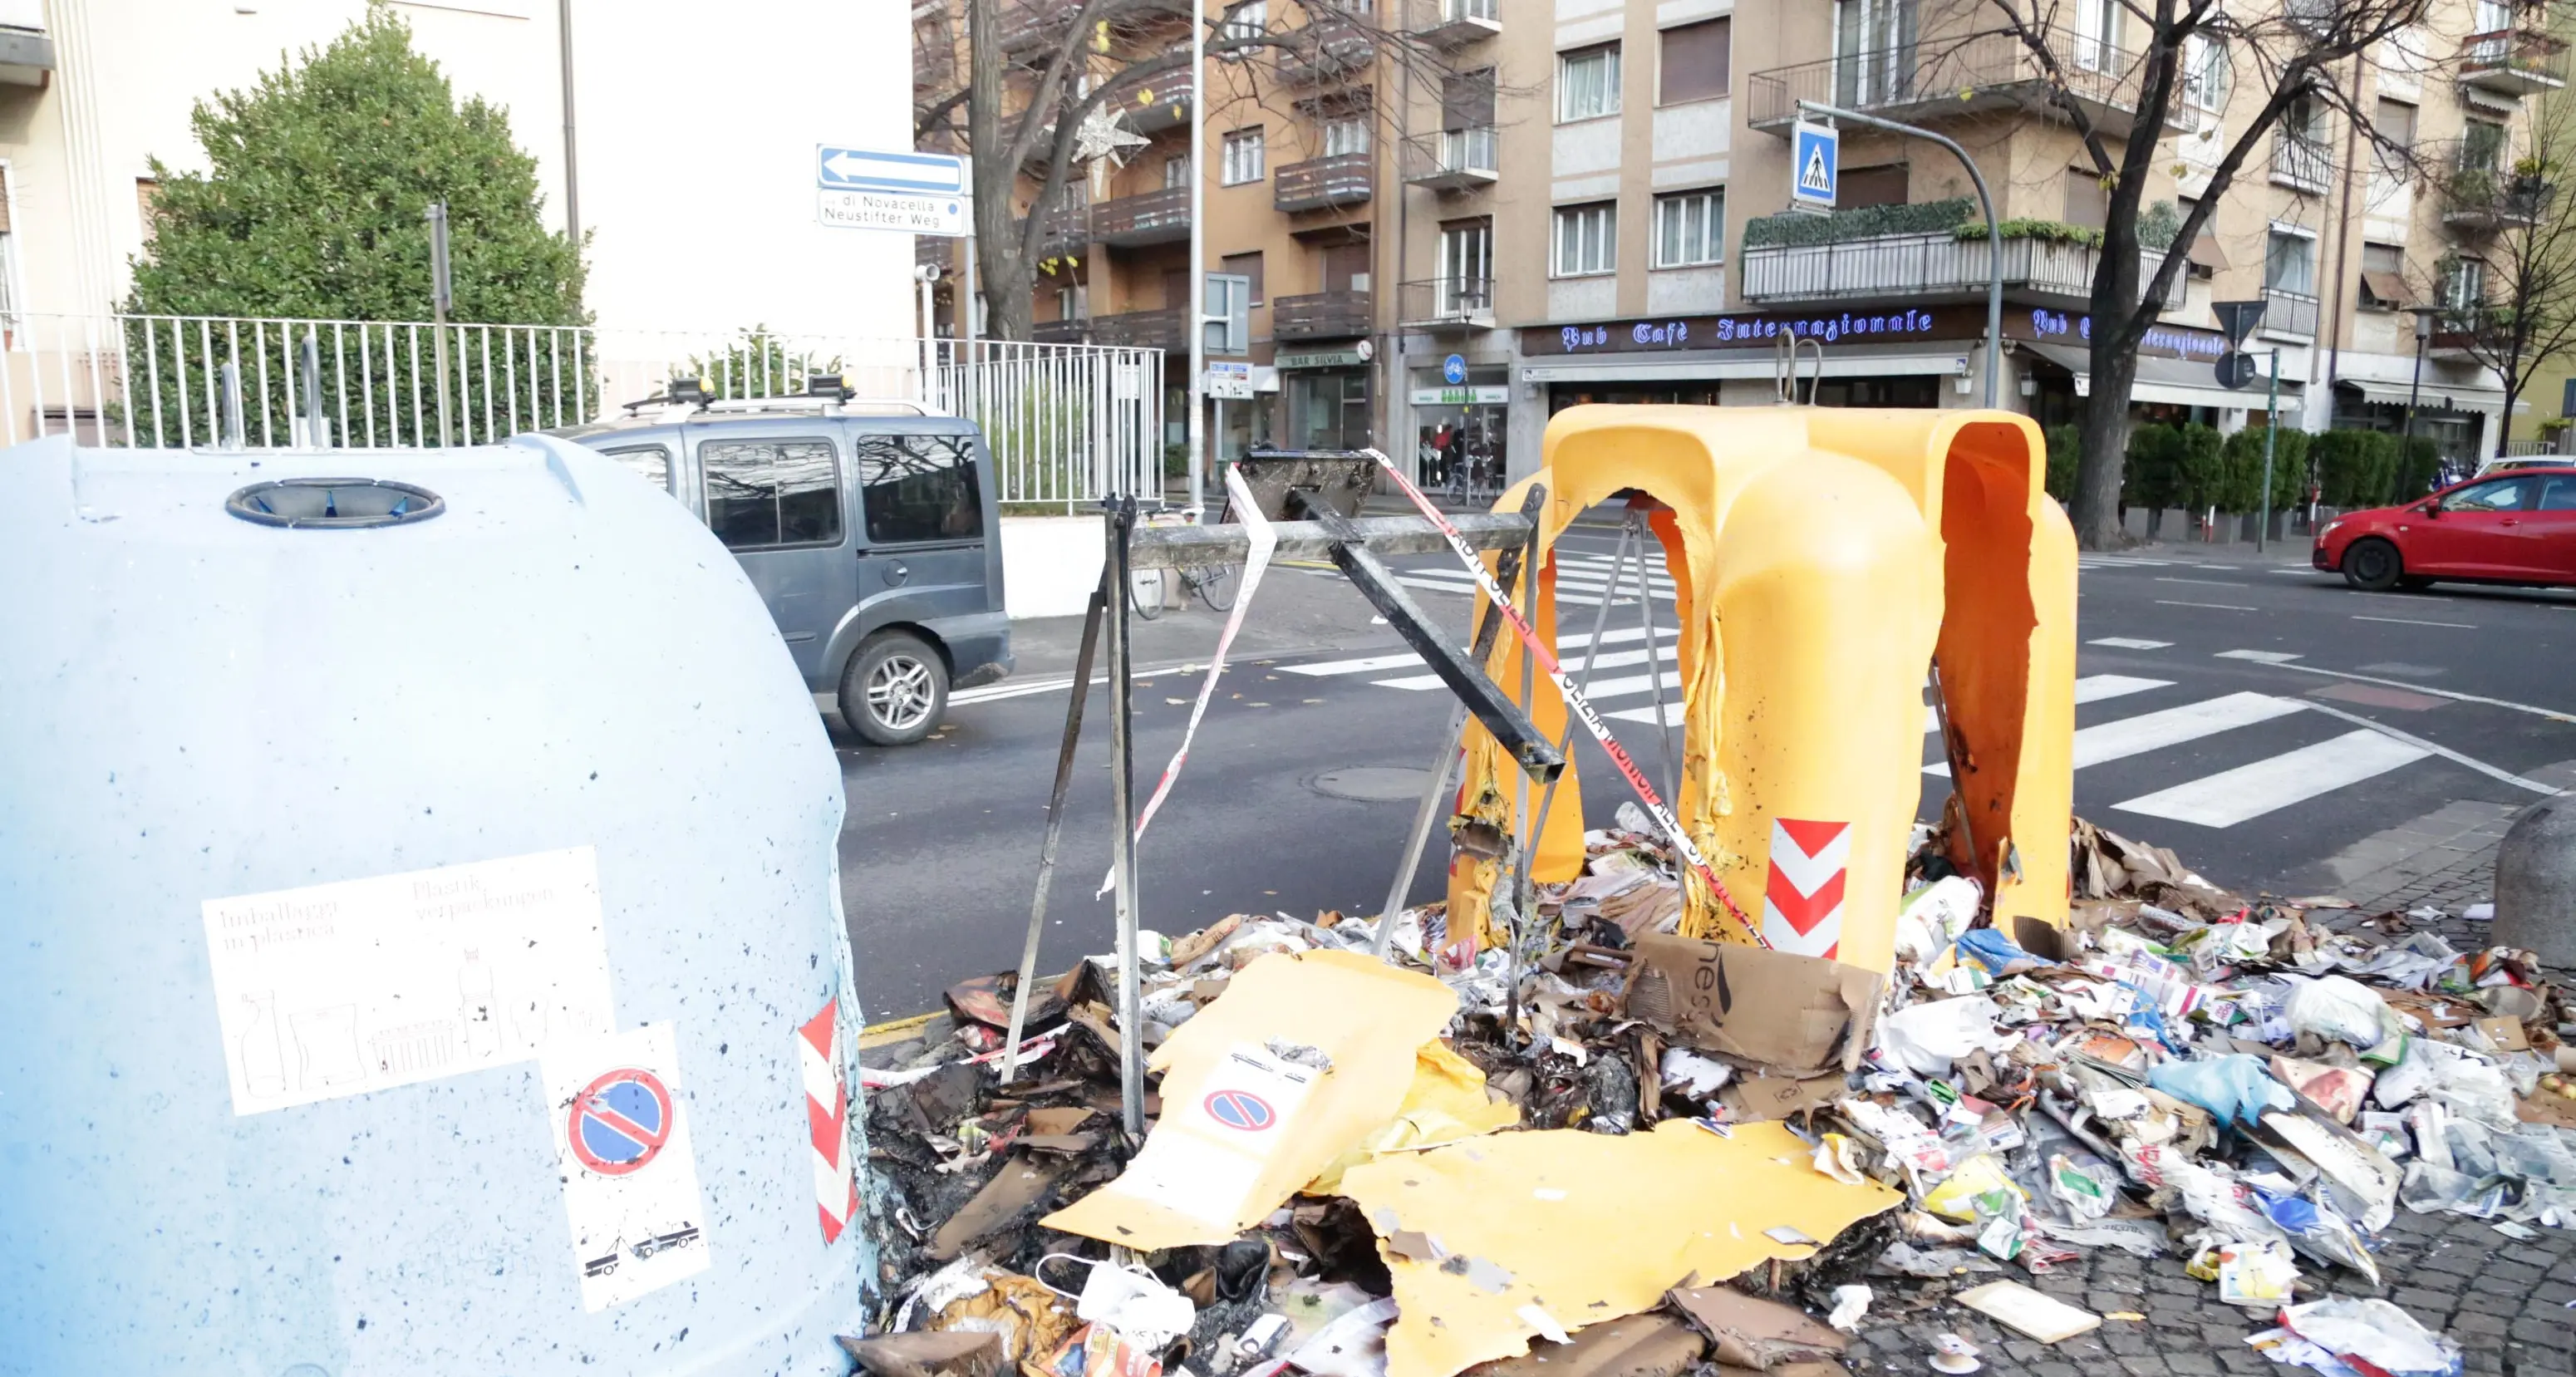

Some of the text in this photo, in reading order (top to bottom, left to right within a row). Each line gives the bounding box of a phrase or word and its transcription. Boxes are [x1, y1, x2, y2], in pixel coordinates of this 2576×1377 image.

[843, 194, 856, 206] di
[863, 196, 935, 212] Novacella
[824, 208, 941, 229] Neustifter Weg
[1561, 327, 1608, 353] Pub
[1717, 309, 1933, 342] Internazionale
[2033, 308, 2068, 339] Pub
[2141, 328, 2225, 357] ternazionale
[1290, 355, 1344, 366] BAR SILVIA
